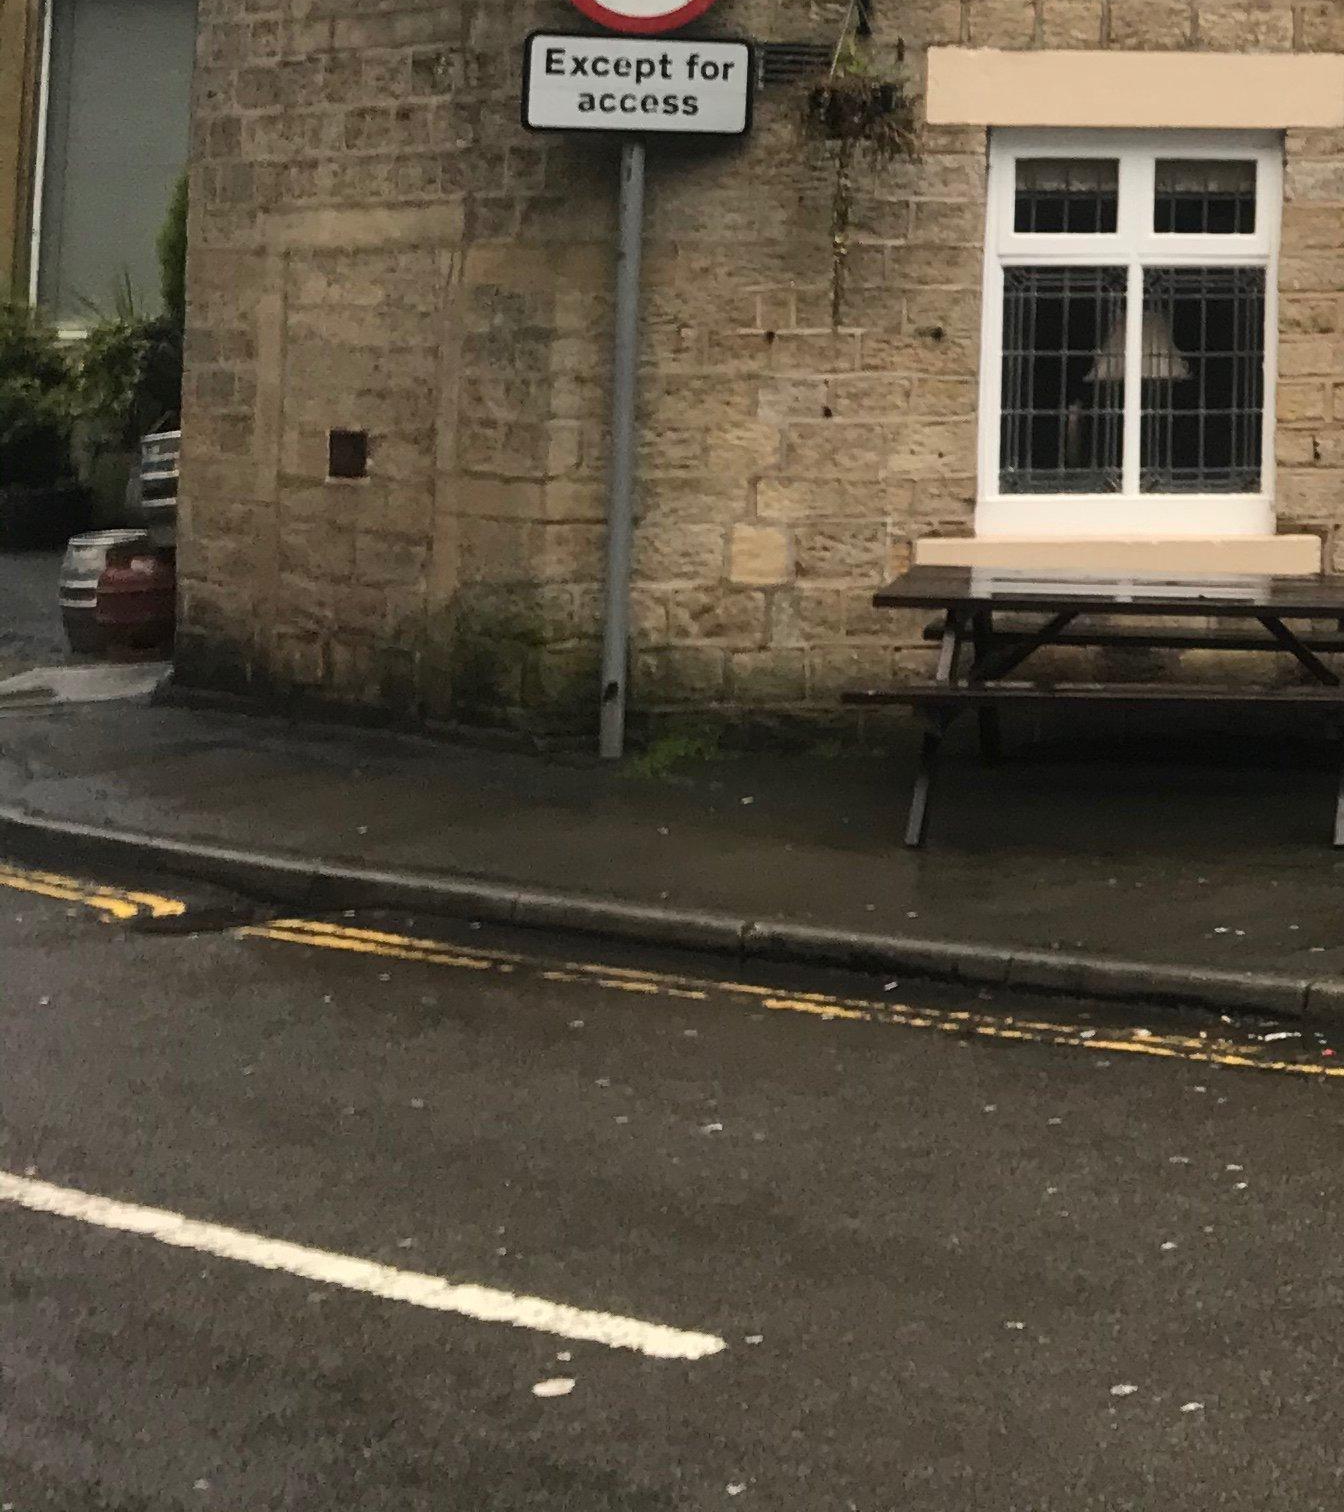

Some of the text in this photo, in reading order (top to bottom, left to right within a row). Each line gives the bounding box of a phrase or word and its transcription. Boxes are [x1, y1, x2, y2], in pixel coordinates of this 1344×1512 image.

[545, 48, 735, 84] Except for
[577, 92, 699, 115] access
